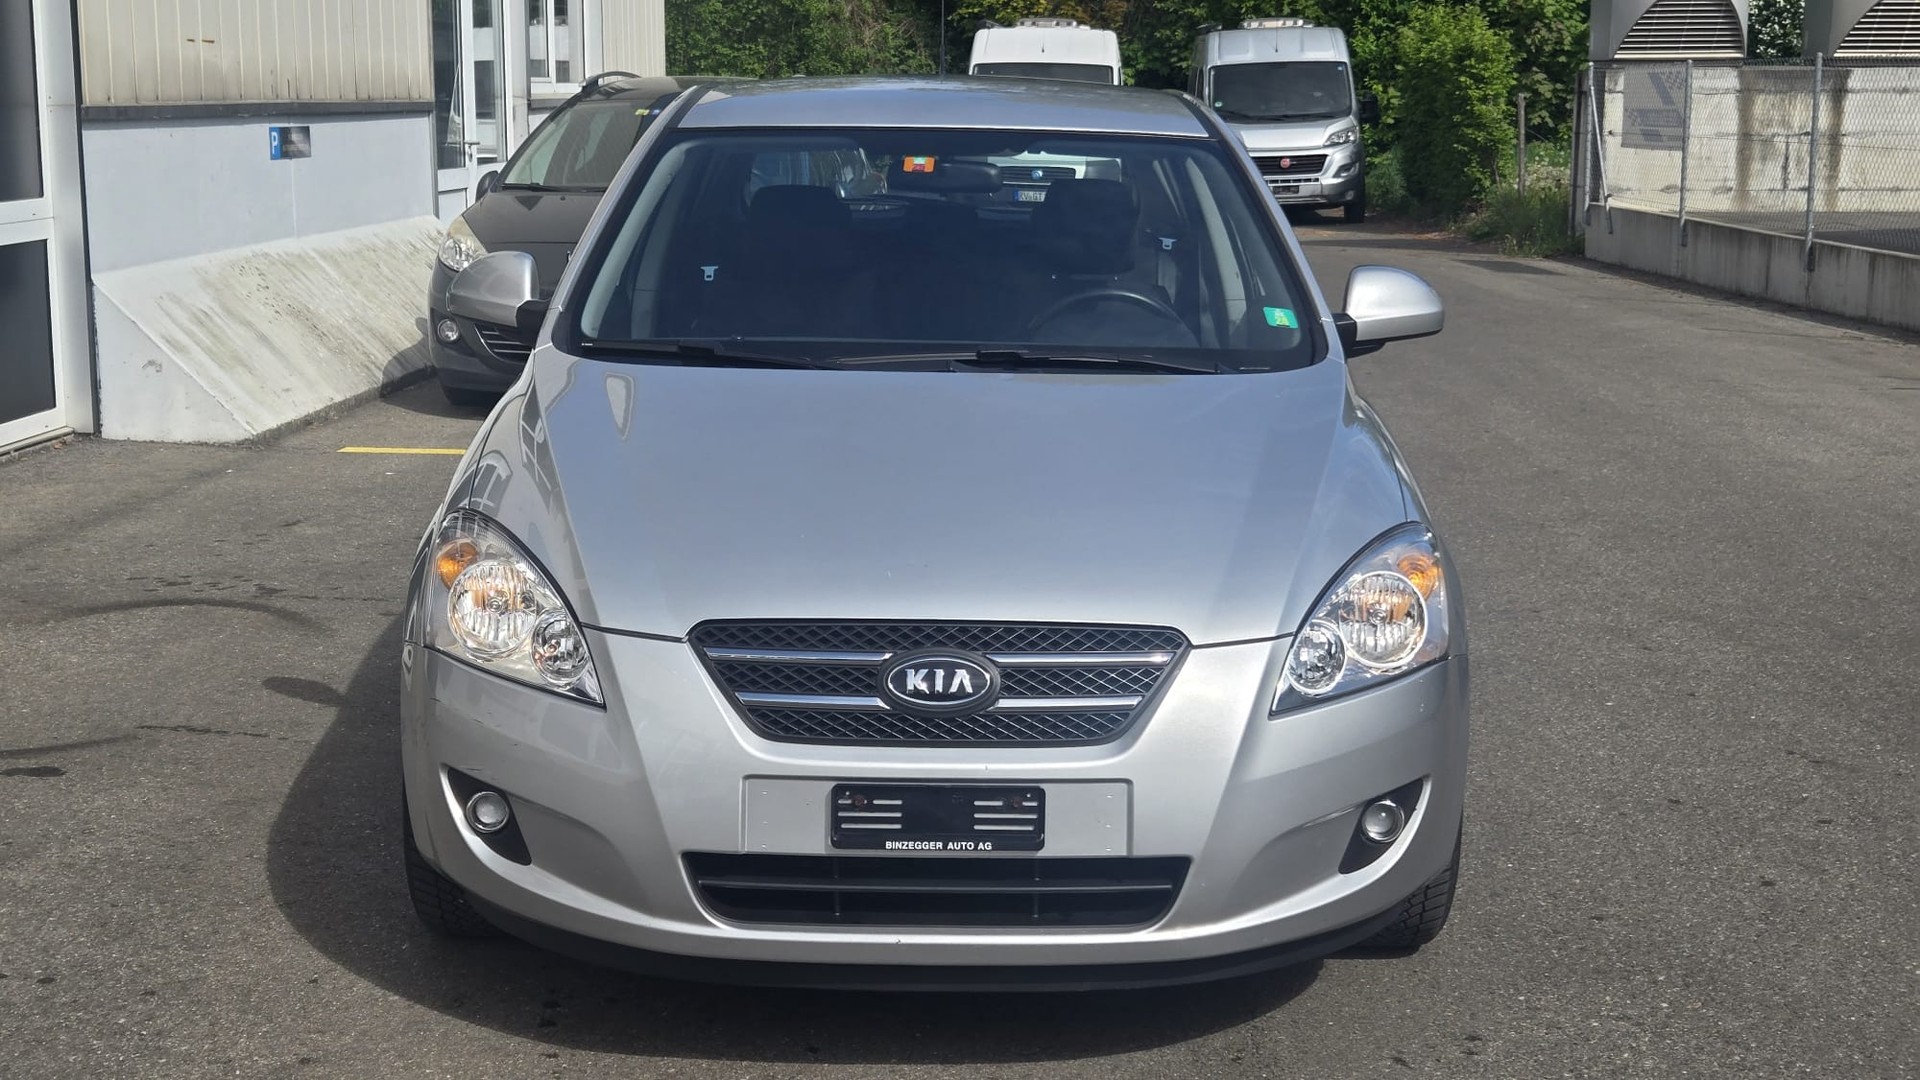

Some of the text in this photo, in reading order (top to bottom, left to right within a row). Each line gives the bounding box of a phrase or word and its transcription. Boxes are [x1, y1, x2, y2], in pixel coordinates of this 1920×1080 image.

[271, 131, 278, 155] P
[905, 668, 974, 694] KIA
[885, 841, 993, 850] BINZEGGER AUTO AG
